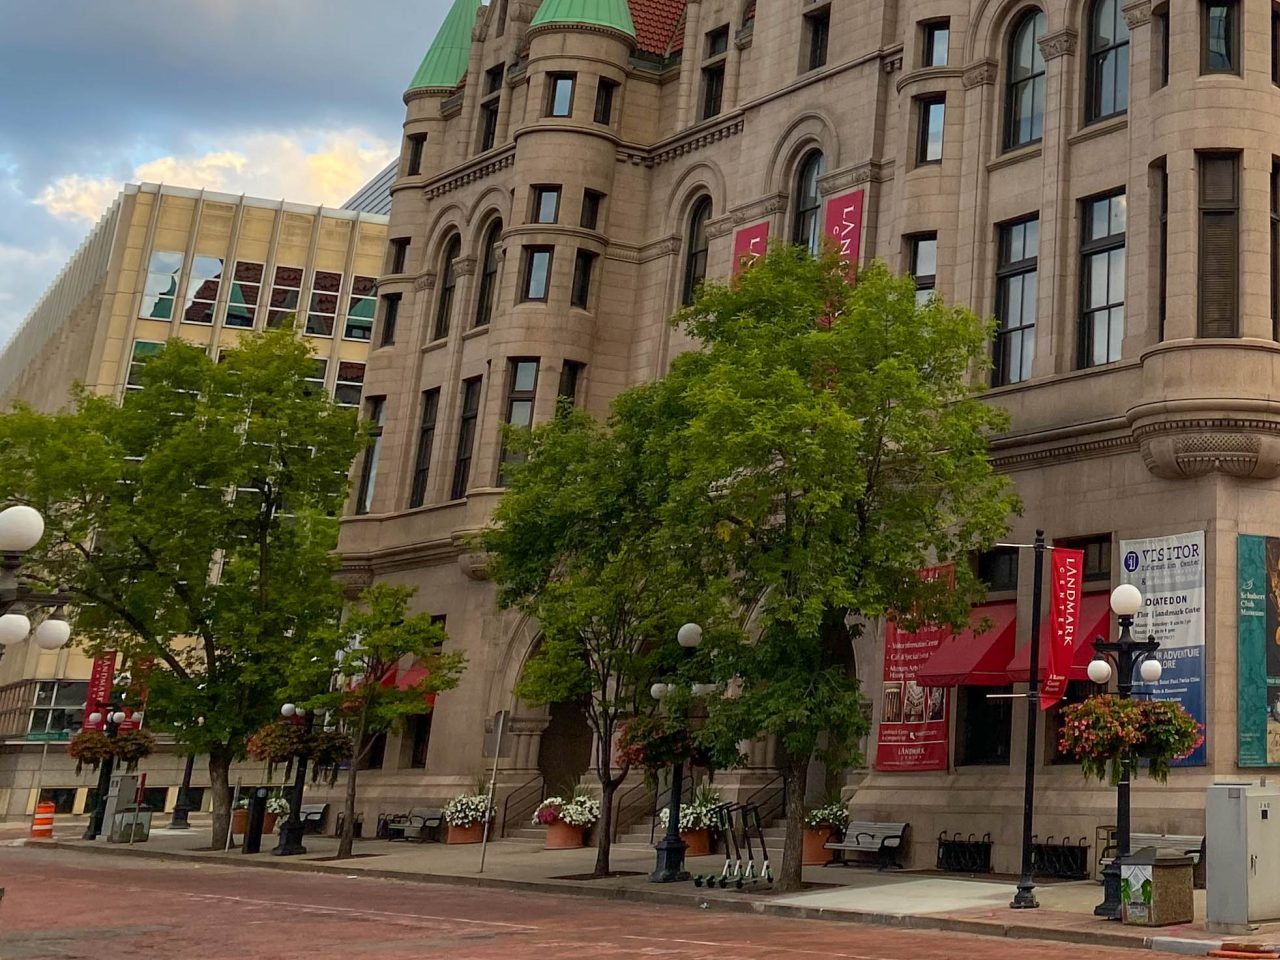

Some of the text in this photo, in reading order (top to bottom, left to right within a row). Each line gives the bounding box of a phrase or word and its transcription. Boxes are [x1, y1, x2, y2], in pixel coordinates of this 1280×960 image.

[1142, 544, 1200, 562] VISITOR
[1057, 567, 1065, 635] CENTER
[1063, 558, 1078, 646] LANDMARK
[1163, 647, 1200, 660] ADVENTURE
